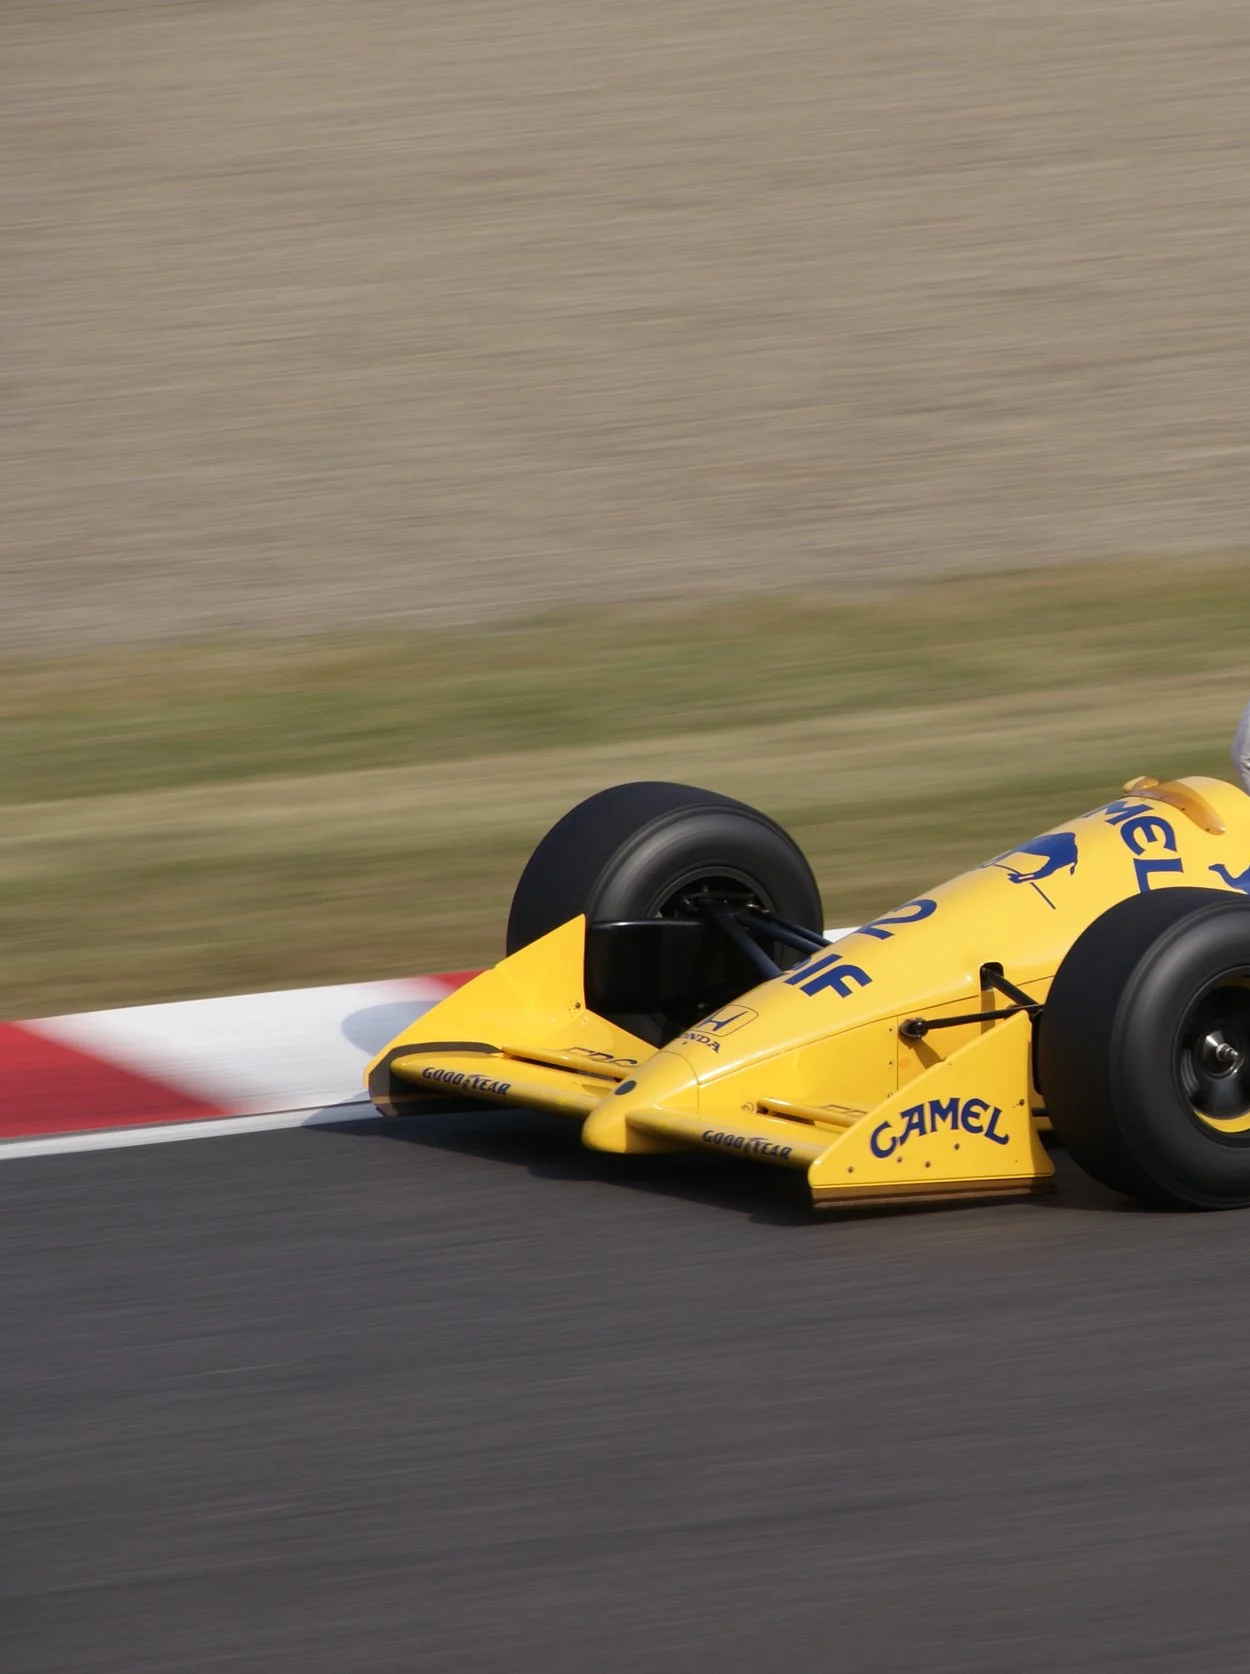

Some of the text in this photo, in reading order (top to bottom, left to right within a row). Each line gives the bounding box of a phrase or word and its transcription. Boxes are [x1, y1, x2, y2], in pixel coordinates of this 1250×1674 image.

[1080, 801, 1184, 893] MEL
[781, 953, 873, 998] lf
[870, 1097, 1010, 1159] CAMEL
